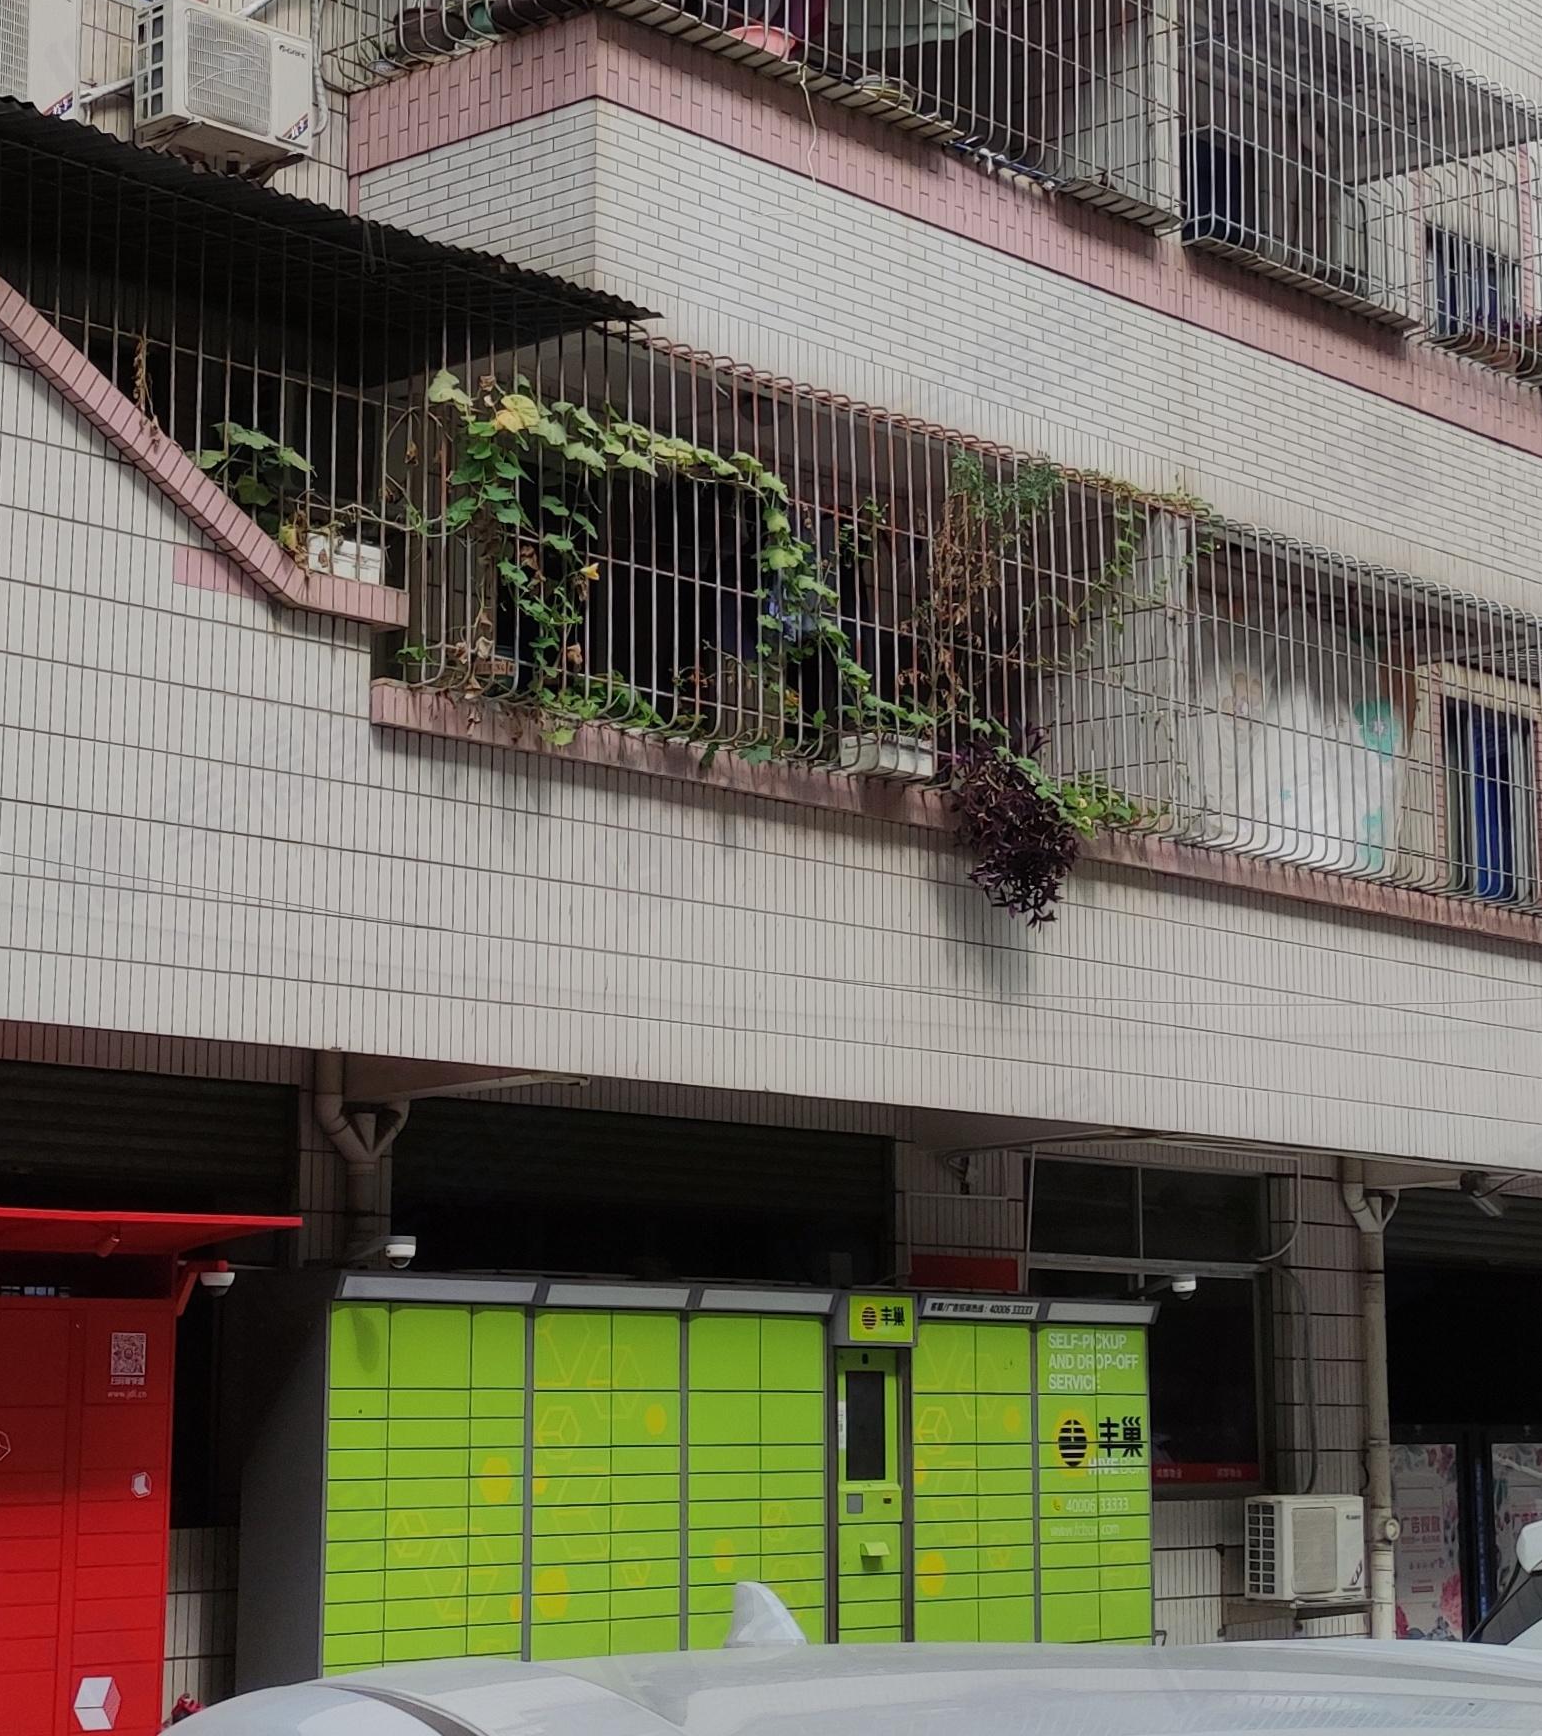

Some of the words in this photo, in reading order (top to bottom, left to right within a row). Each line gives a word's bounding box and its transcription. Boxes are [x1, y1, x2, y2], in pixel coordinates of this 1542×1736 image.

[880, 1305, 905, 1326] 丰巢
[1048, 1333, 1127, 1350] SELF-PICKUP
[1049, 1354, 1075, 1370] AND
[1077, 1354, 1139, 1371] DROP-OFF
[1048, 1374, 1101, 1391] SERVICE
[1098, 1416, 1144, 1457] 丰巢
